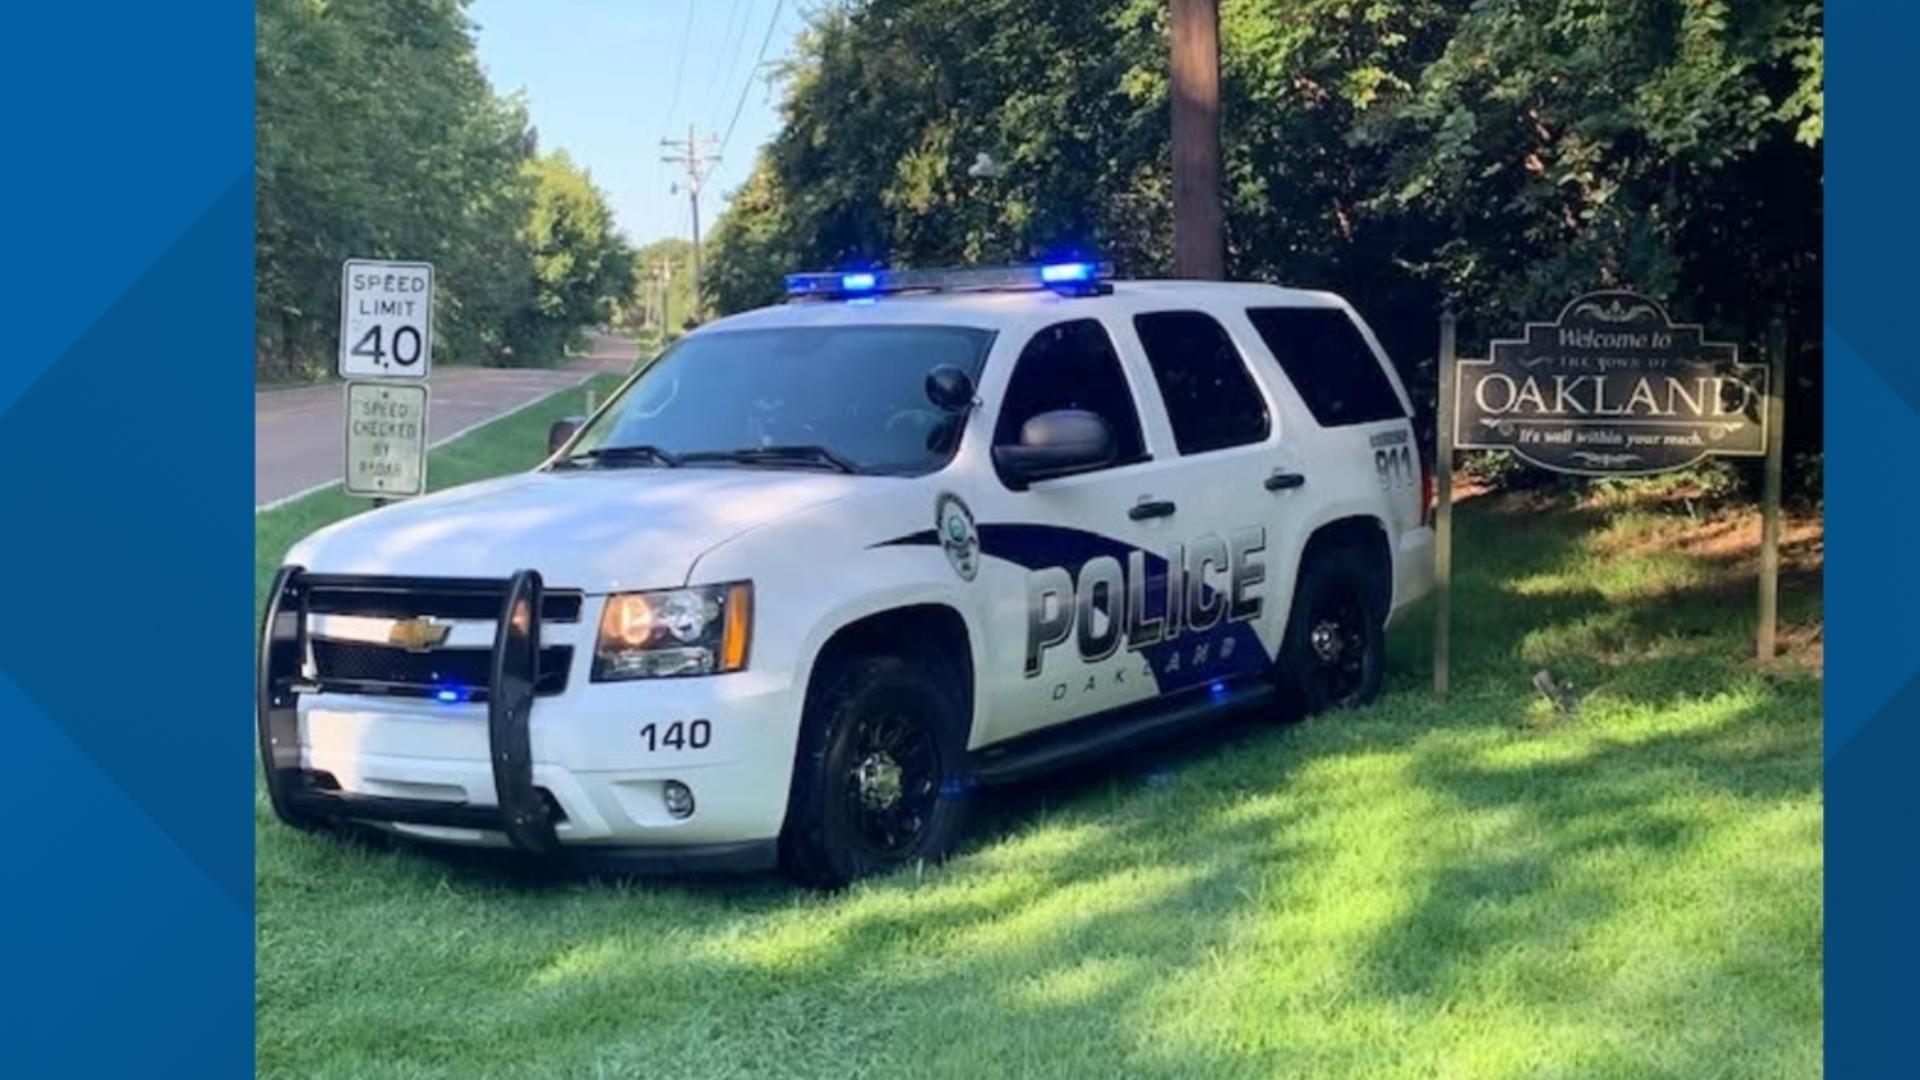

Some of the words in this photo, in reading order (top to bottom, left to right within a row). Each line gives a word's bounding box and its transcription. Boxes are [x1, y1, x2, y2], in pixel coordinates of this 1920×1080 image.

[353, 274, 425, 293] SPEED
[360, 300, 416, 317] LIMIT
[350, 324, 422, 367] 40
[1558, 328, 1648, 349] Welcome
[1652, 329, 1672, 349] to
[1475, 373, 1749, 417] OAKLAND
[362, 402, 408, 418] SPEED
[353, 421, 416, 438] CHECKED
[1518, 429, 1541, 443] It's
[1544, 430, 1573, 444] well
[1577, 430, 1622, 444] within
[1626, 434, 1660, 447] your
[1375, 446, 1414, 491] 911
[1023, 526, 1267, 680] POLICE
[1052, 636, 1237, 701] OAKLAND
[640, 719, 712, 752] 140
